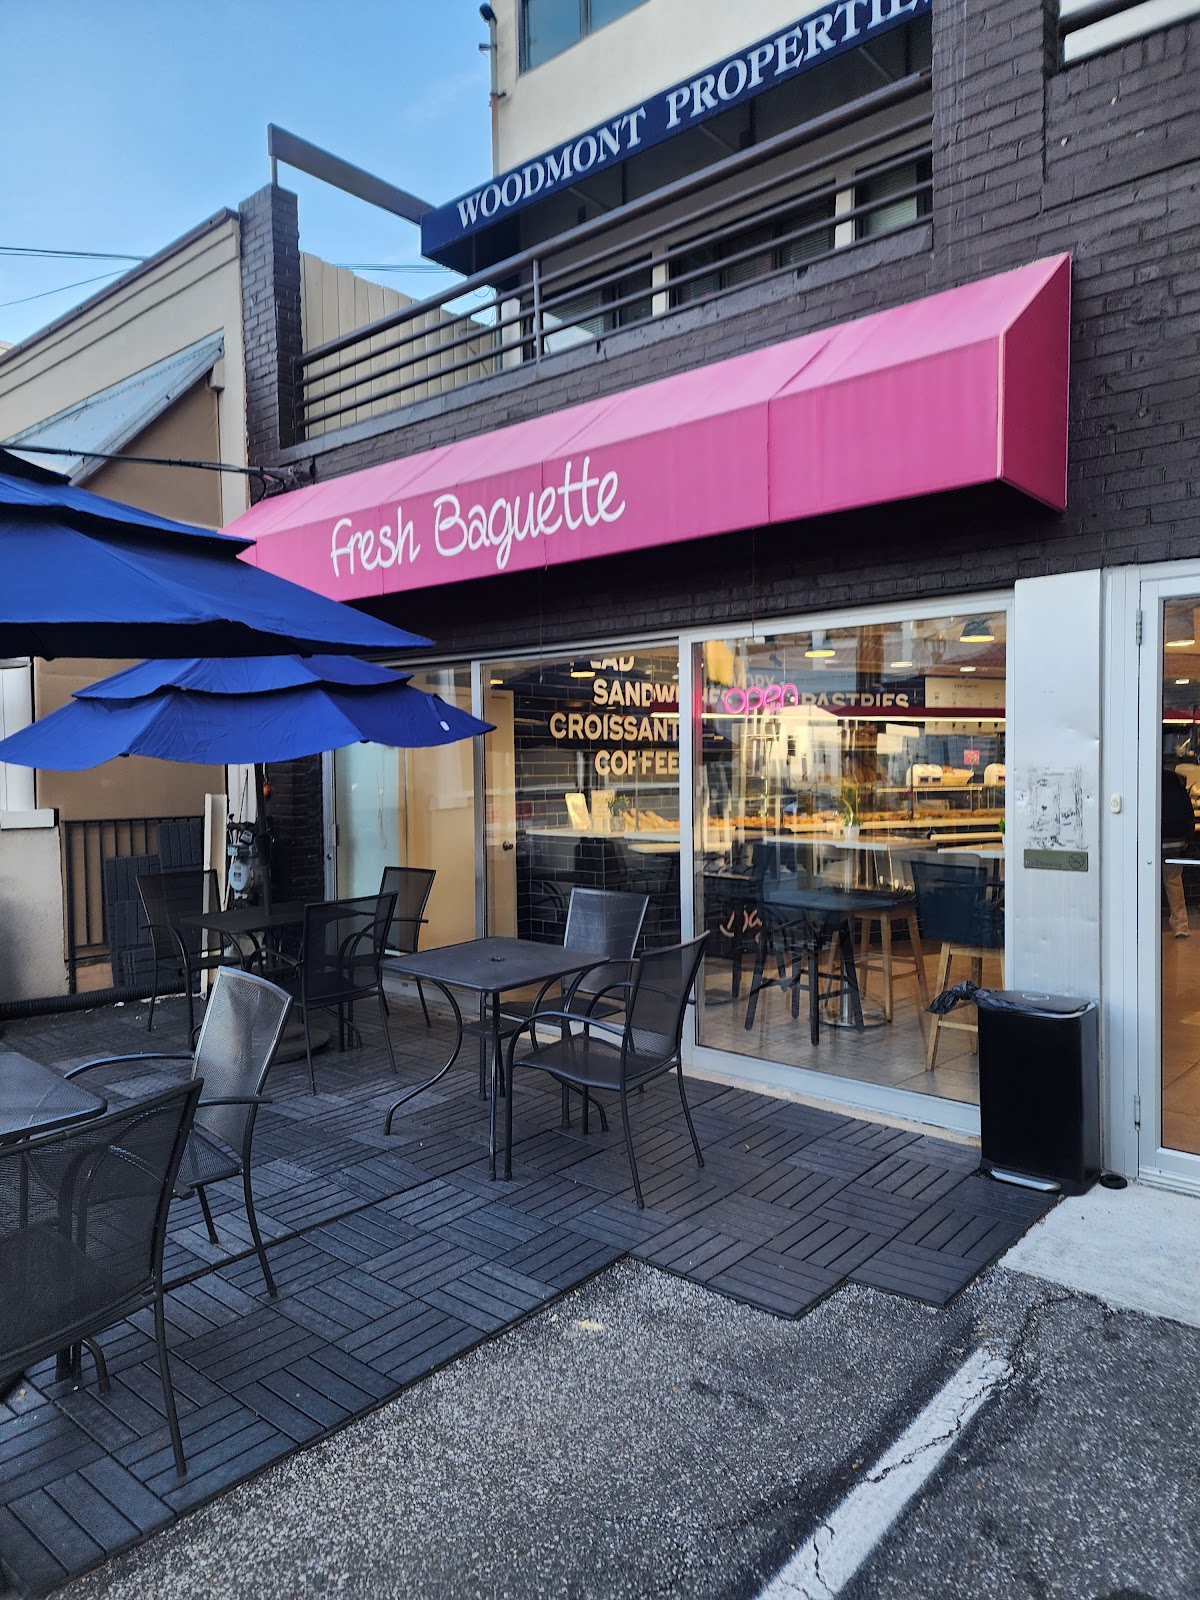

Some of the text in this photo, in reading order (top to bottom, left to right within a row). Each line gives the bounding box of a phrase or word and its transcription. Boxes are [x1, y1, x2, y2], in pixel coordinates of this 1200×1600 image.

[456, 0, 929, 230] WOODMONT PROPERTI
[433, 455, 626, 570] Baguette
[723, 682, 799, 719] open
[594, 749, 680, 776] COFFEE
